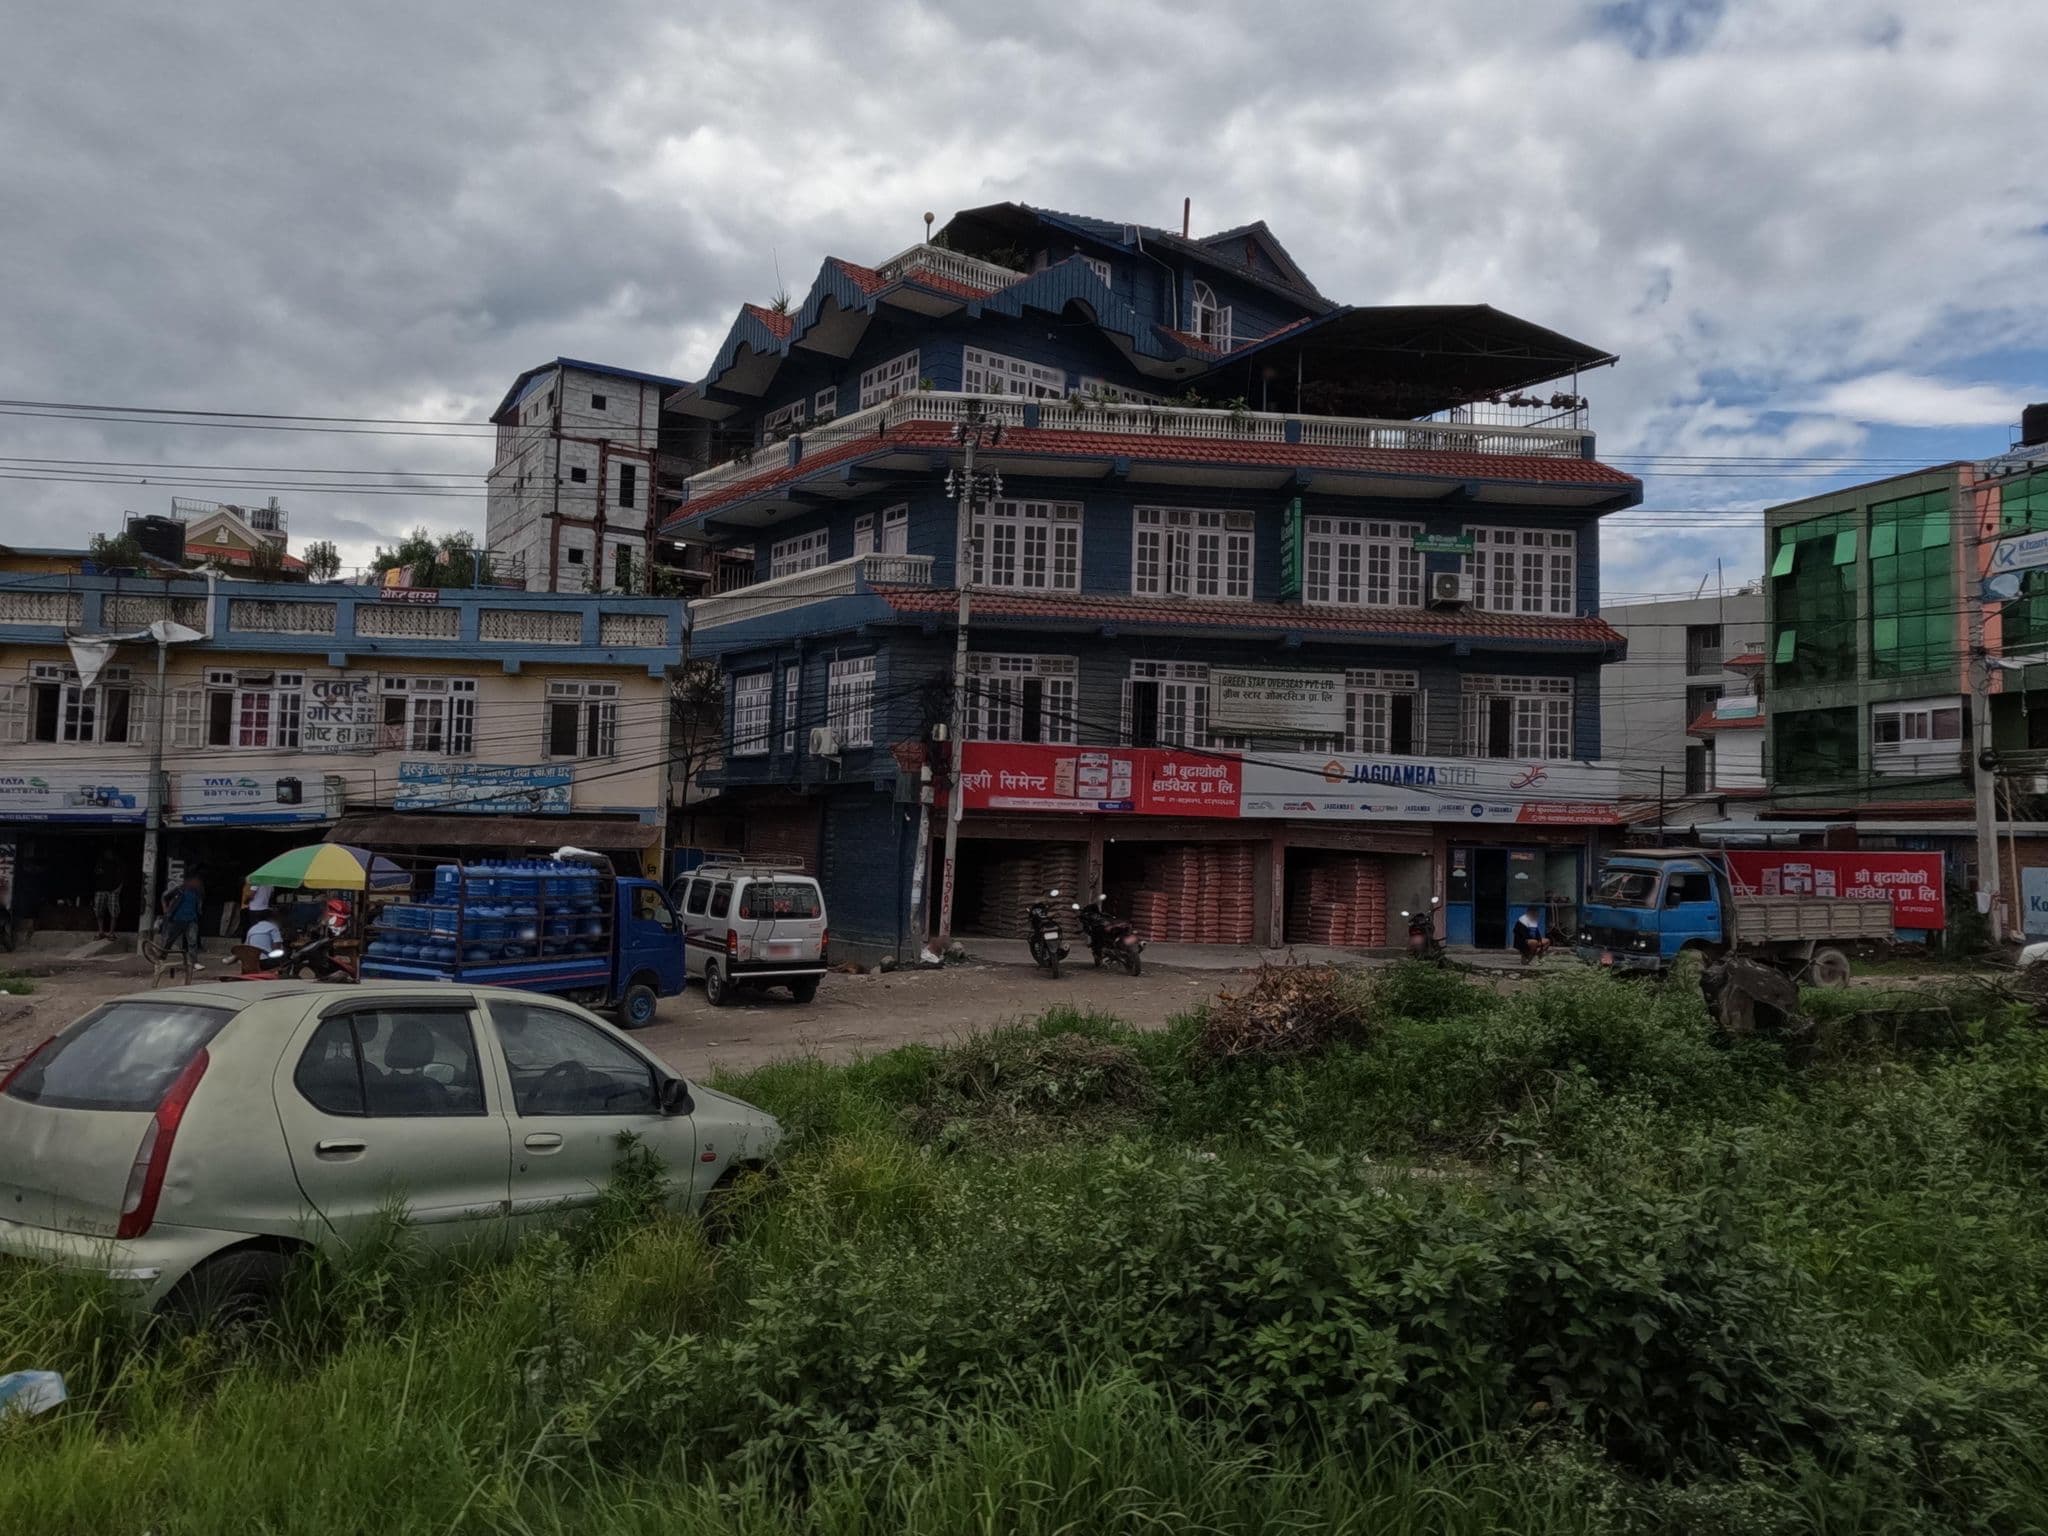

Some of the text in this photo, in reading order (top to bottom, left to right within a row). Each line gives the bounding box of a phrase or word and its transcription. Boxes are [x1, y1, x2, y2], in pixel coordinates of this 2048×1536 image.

[1222, 676, 1246, 687] GREEN
[1248, 677, 1265, 688] STAR
[1267, 679, 1303, 689] OVERSEAS
[1162, 763, 1178, 778] श्री
[1348, 764, 1476, 785] JAGDAMBA STEEL
[0, 778, 25, 786] TATA
[203, 778, 233, 786] TATA
[1000, 769, 1048, 791] सिमेन्ट
[1854, 868, 1870, 883] श्री
